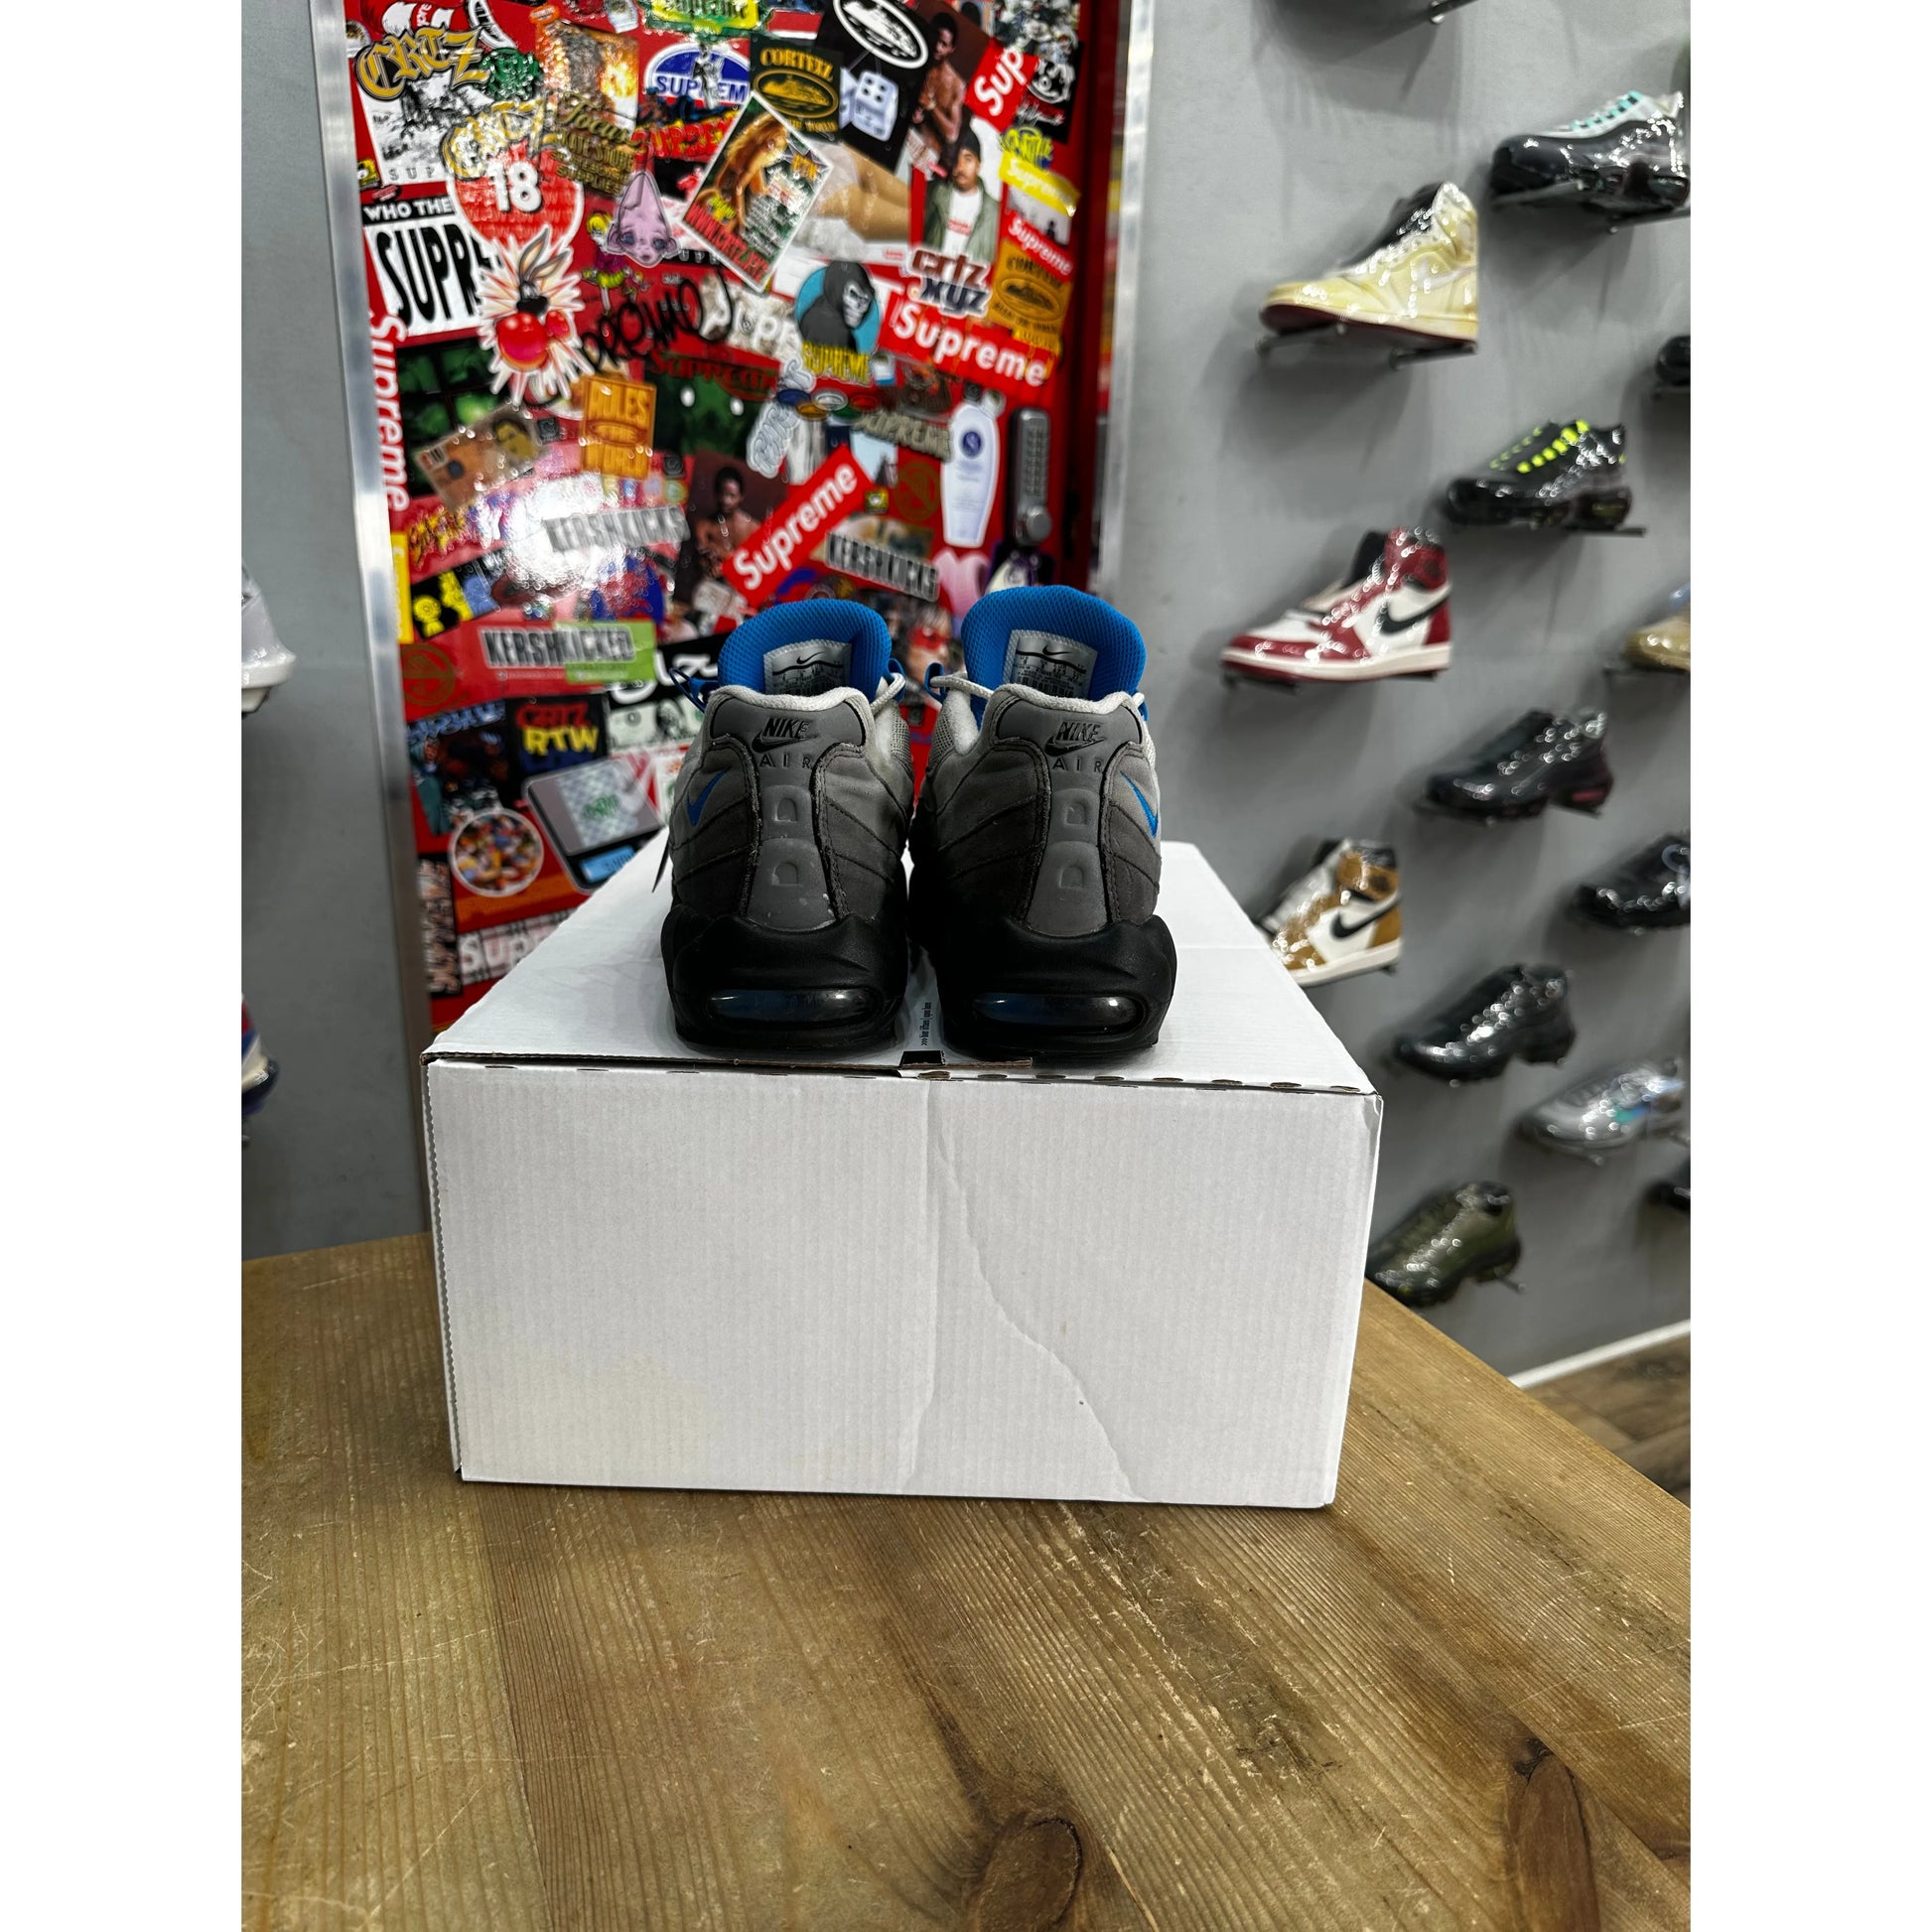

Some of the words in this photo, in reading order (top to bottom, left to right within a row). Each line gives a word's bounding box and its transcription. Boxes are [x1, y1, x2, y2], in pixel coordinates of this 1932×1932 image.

[355, 26, 491, 100] CRTZ
[485, 159, 542, 212] 18
[363, 202, 412, 221] WHO
[413, 198, 454, 214] THE
[1008, 216, 1073, 276] Supreme
[893, 302, 1048, 387] Supreme
[369, 315, 410, 511] Supreme
[733, 462, 858, 590] Supreme
[523, 726, 599, 756] RTW
[762, 717, 809, 740] NIKE
[1056, 721, 1102, 743] NIKE
[759, 753, 811, 768] AIR
[1052, 758, 1105, 773] AIR
